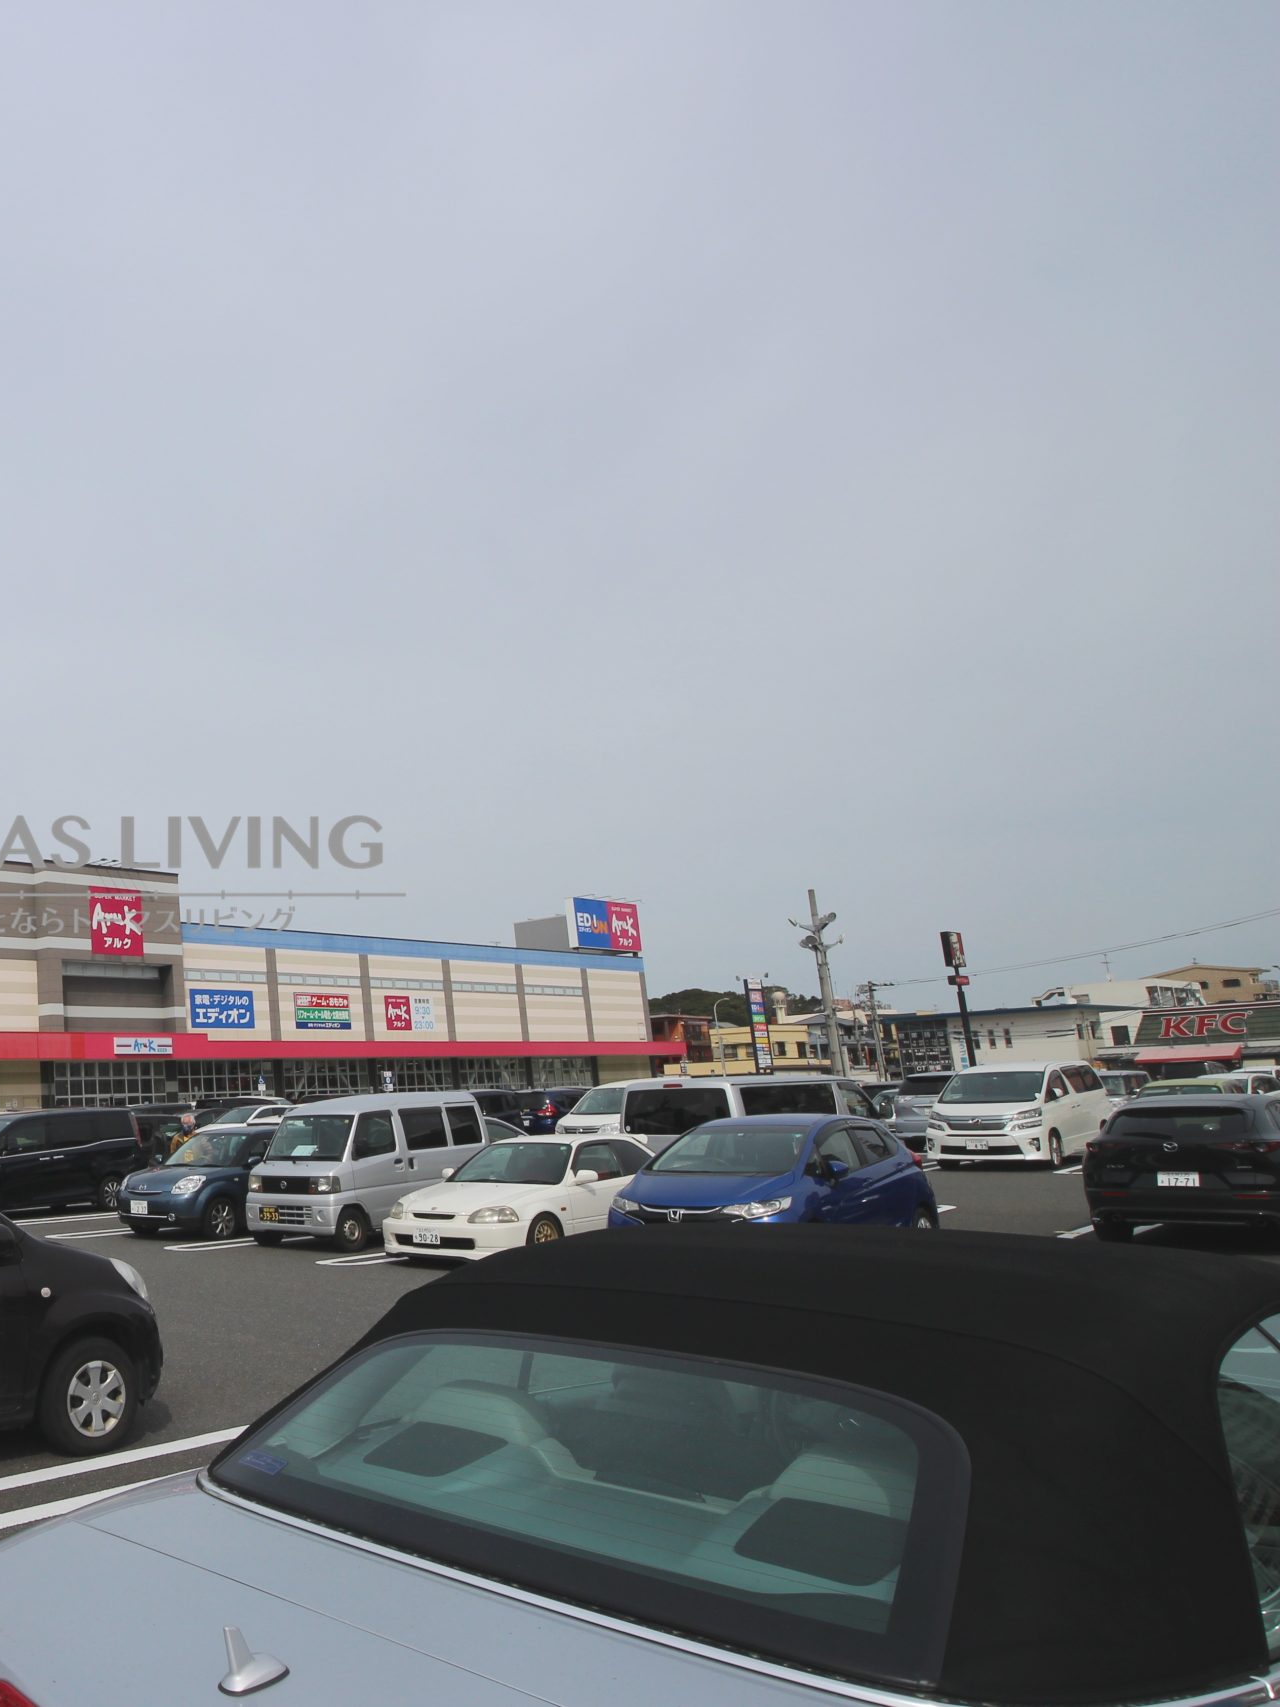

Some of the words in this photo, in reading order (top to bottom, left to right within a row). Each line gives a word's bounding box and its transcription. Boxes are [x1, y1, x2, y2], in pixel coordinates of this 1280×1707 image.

[104, 937, 131, 949] アルク
[618, 938, 633, 946] アルク
[195, 994, 249, 1006] 家電・デジタルの
[196, 1008, 250, 1024] エディオン
[1159, 1011, 1248, 1038] KFC
